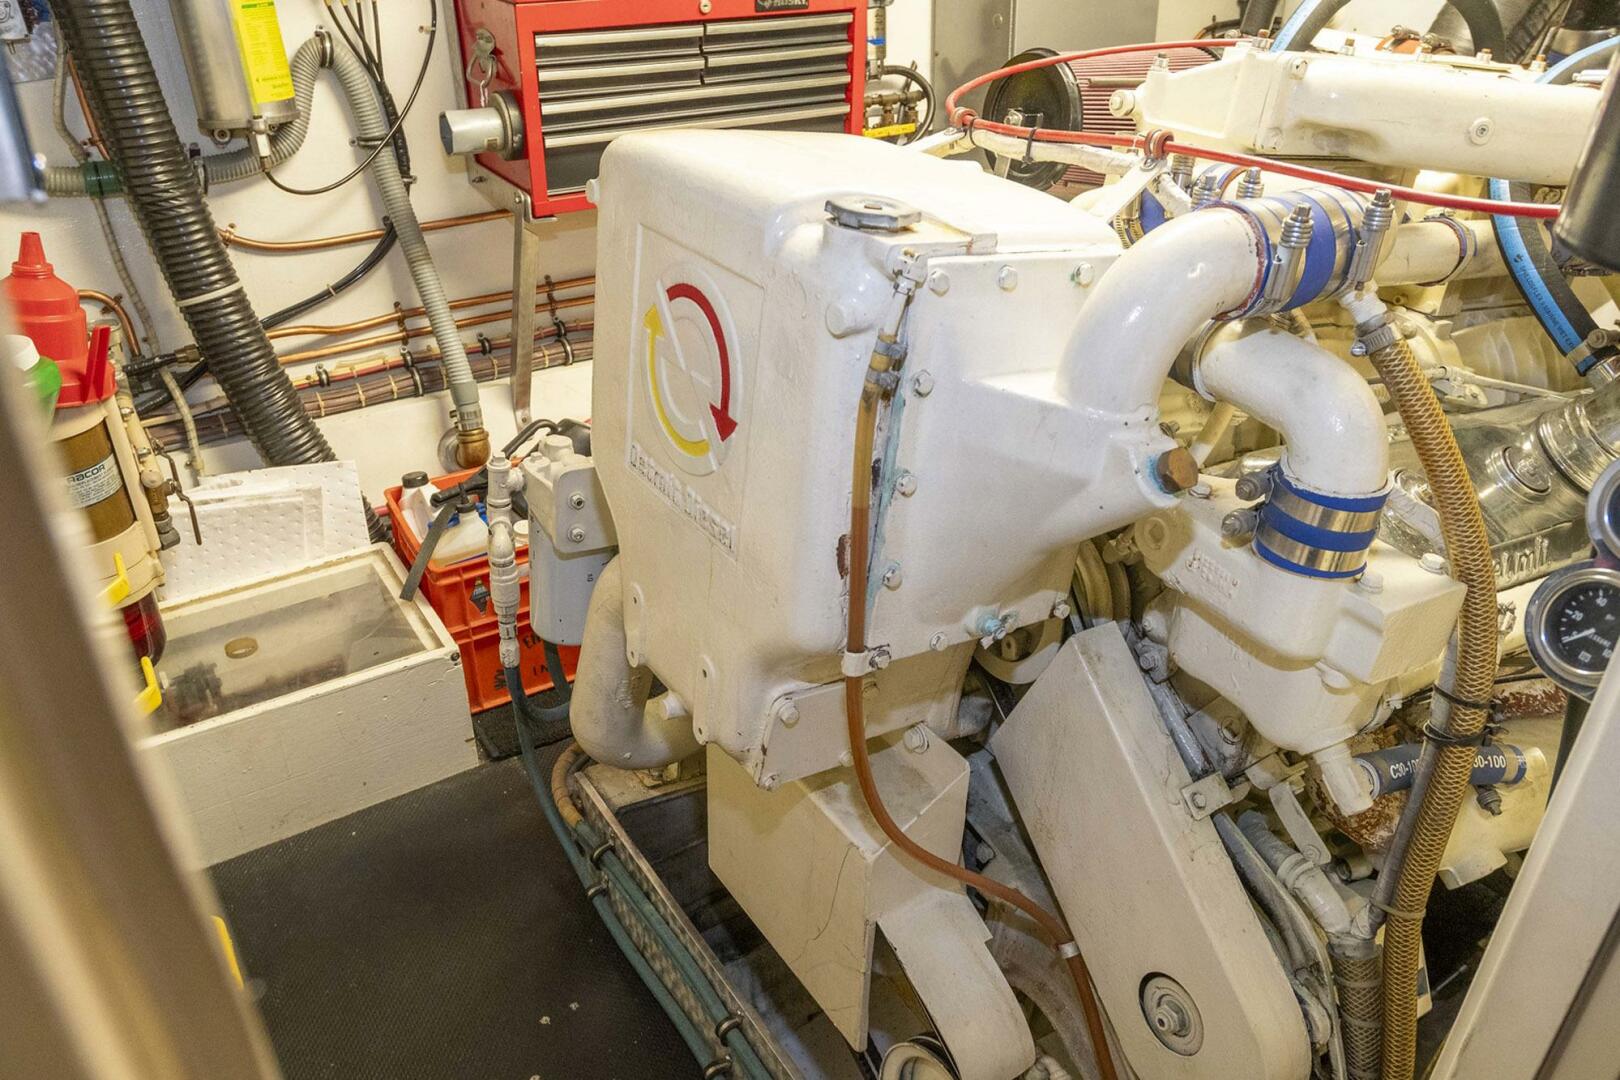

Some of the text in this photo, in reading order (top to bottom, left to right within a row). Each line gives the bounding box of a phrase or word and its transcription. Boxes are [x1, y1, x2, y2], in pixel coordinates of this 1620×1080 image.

[1571, 610, 1584, 621] 20
[1473, 755, 1507, 768] 30-100
[1390, 759, 1420, 779] C30-10
